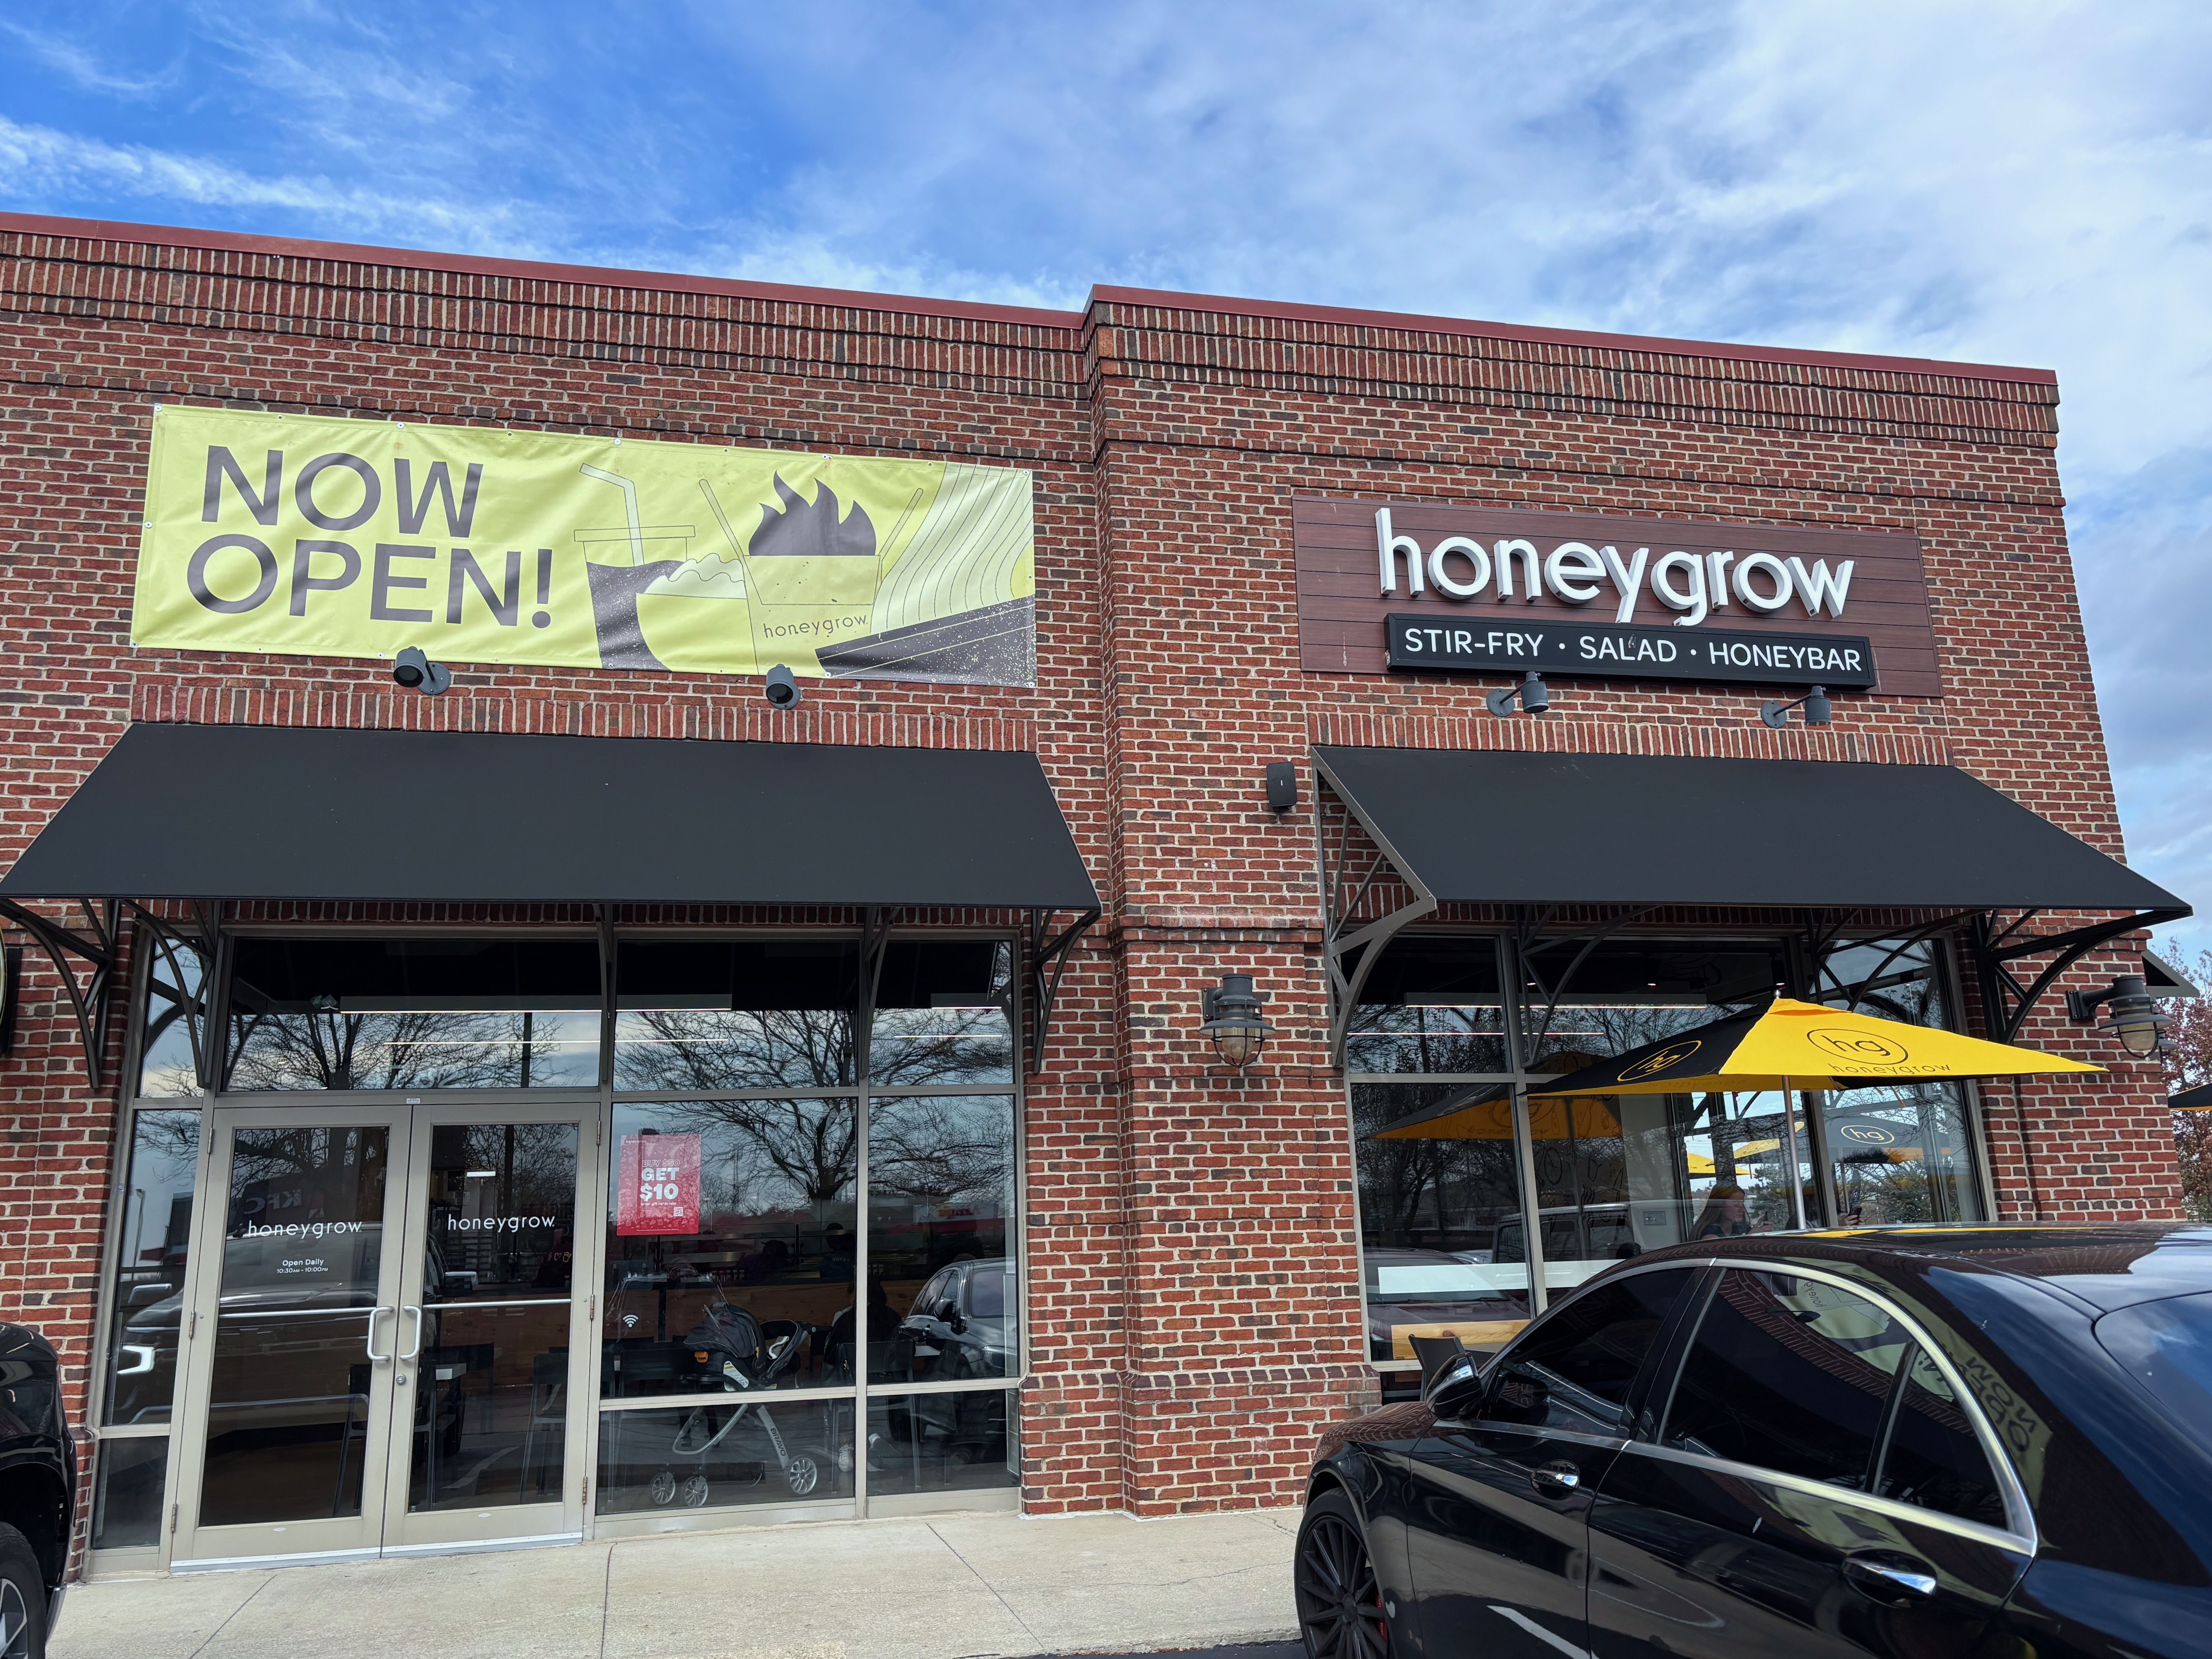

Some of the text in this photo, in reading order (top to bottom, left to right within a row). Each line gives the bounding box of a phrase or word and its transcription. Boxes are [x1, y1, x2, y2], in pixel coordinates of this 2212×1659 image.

[202, 446, 483, 537] NOW
[1375, 508, 1854, 626] honeygrow
[187, 534, 553, 628] OPEN!
[763, 615, 867, 638] honeygrow
[1405, 628, 1860, 672] STIR-FRY SALAD HONEYBAR
[1821, 1035, 1891, 1056] hg
[1827, 1062, 1951, 1075] honeygrow
[1849, 1128, 1885, 1141] hg
[642, 1159, 680, 1167] BUY $50
[641, 1167, 680, 1181] GET
[639, 1183, 679, 1202] $10
[248, 1220, 362, 1239] honeygrow
[448, 1214, 555, 1233] honeygrow
[771, 1428, 786, 1456] BRAVO
